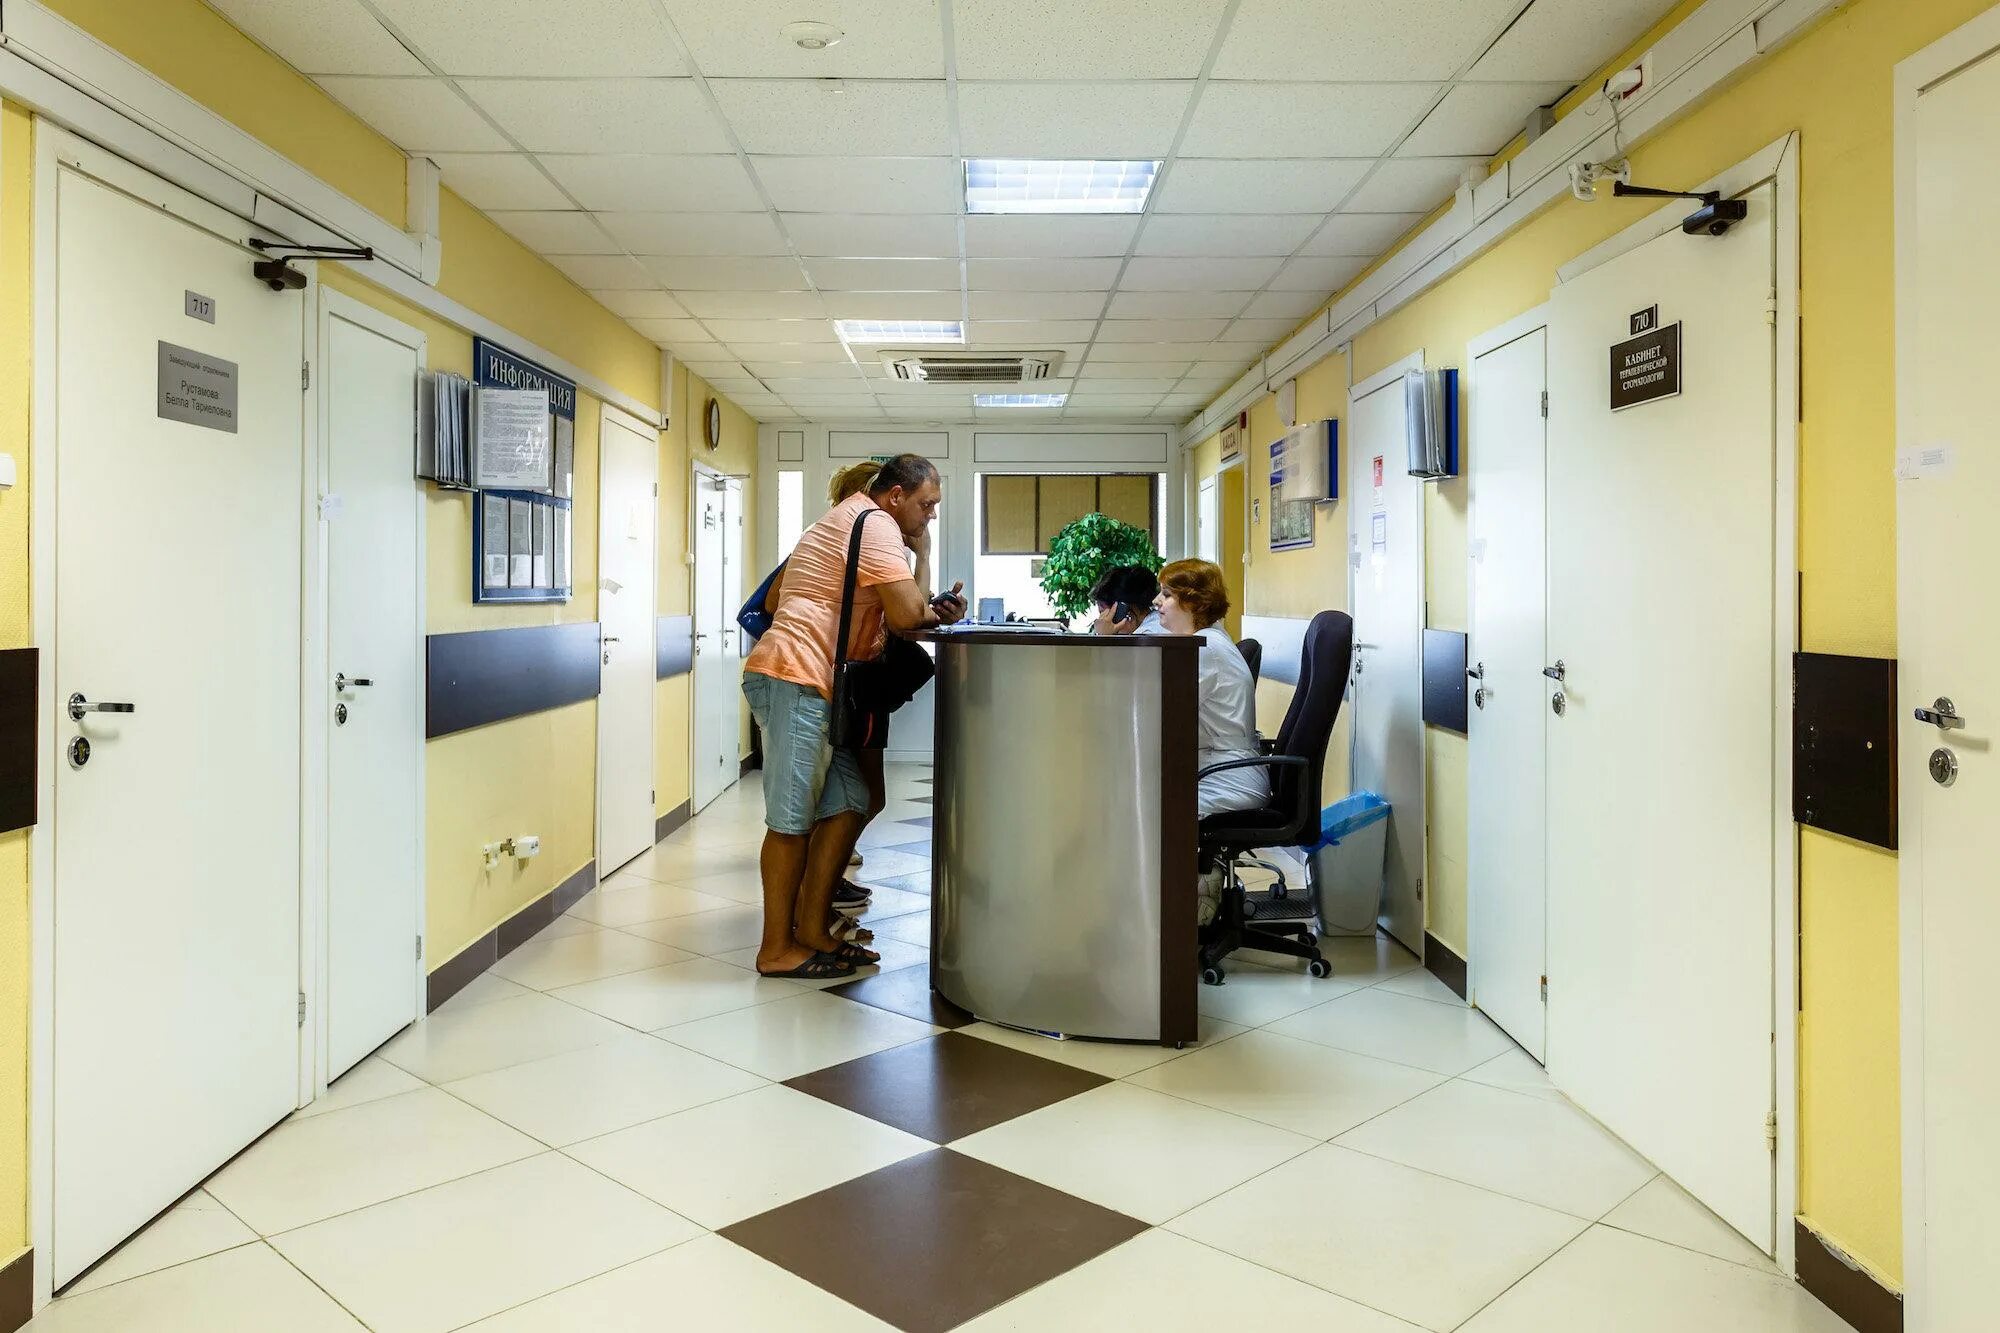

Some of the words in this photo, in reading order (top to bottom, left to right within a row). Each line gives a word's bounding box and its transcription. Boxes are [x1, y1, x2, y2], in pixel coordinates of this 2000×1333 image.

[193, 298, 209, 316] 717
[1634, 312, 1649, 332] 710
[1625, 345, 1662, 367] КАБИНЕТ
[1619, 356, 1668, 380] ТЕРАПЕВТИЧЕСКОЙ
[181, 379, 219, 400] Рустамова
[1622, 370, 1665, 391] СТОМАТОЛОГИИ
[165, 392, 189, 408] Белла
